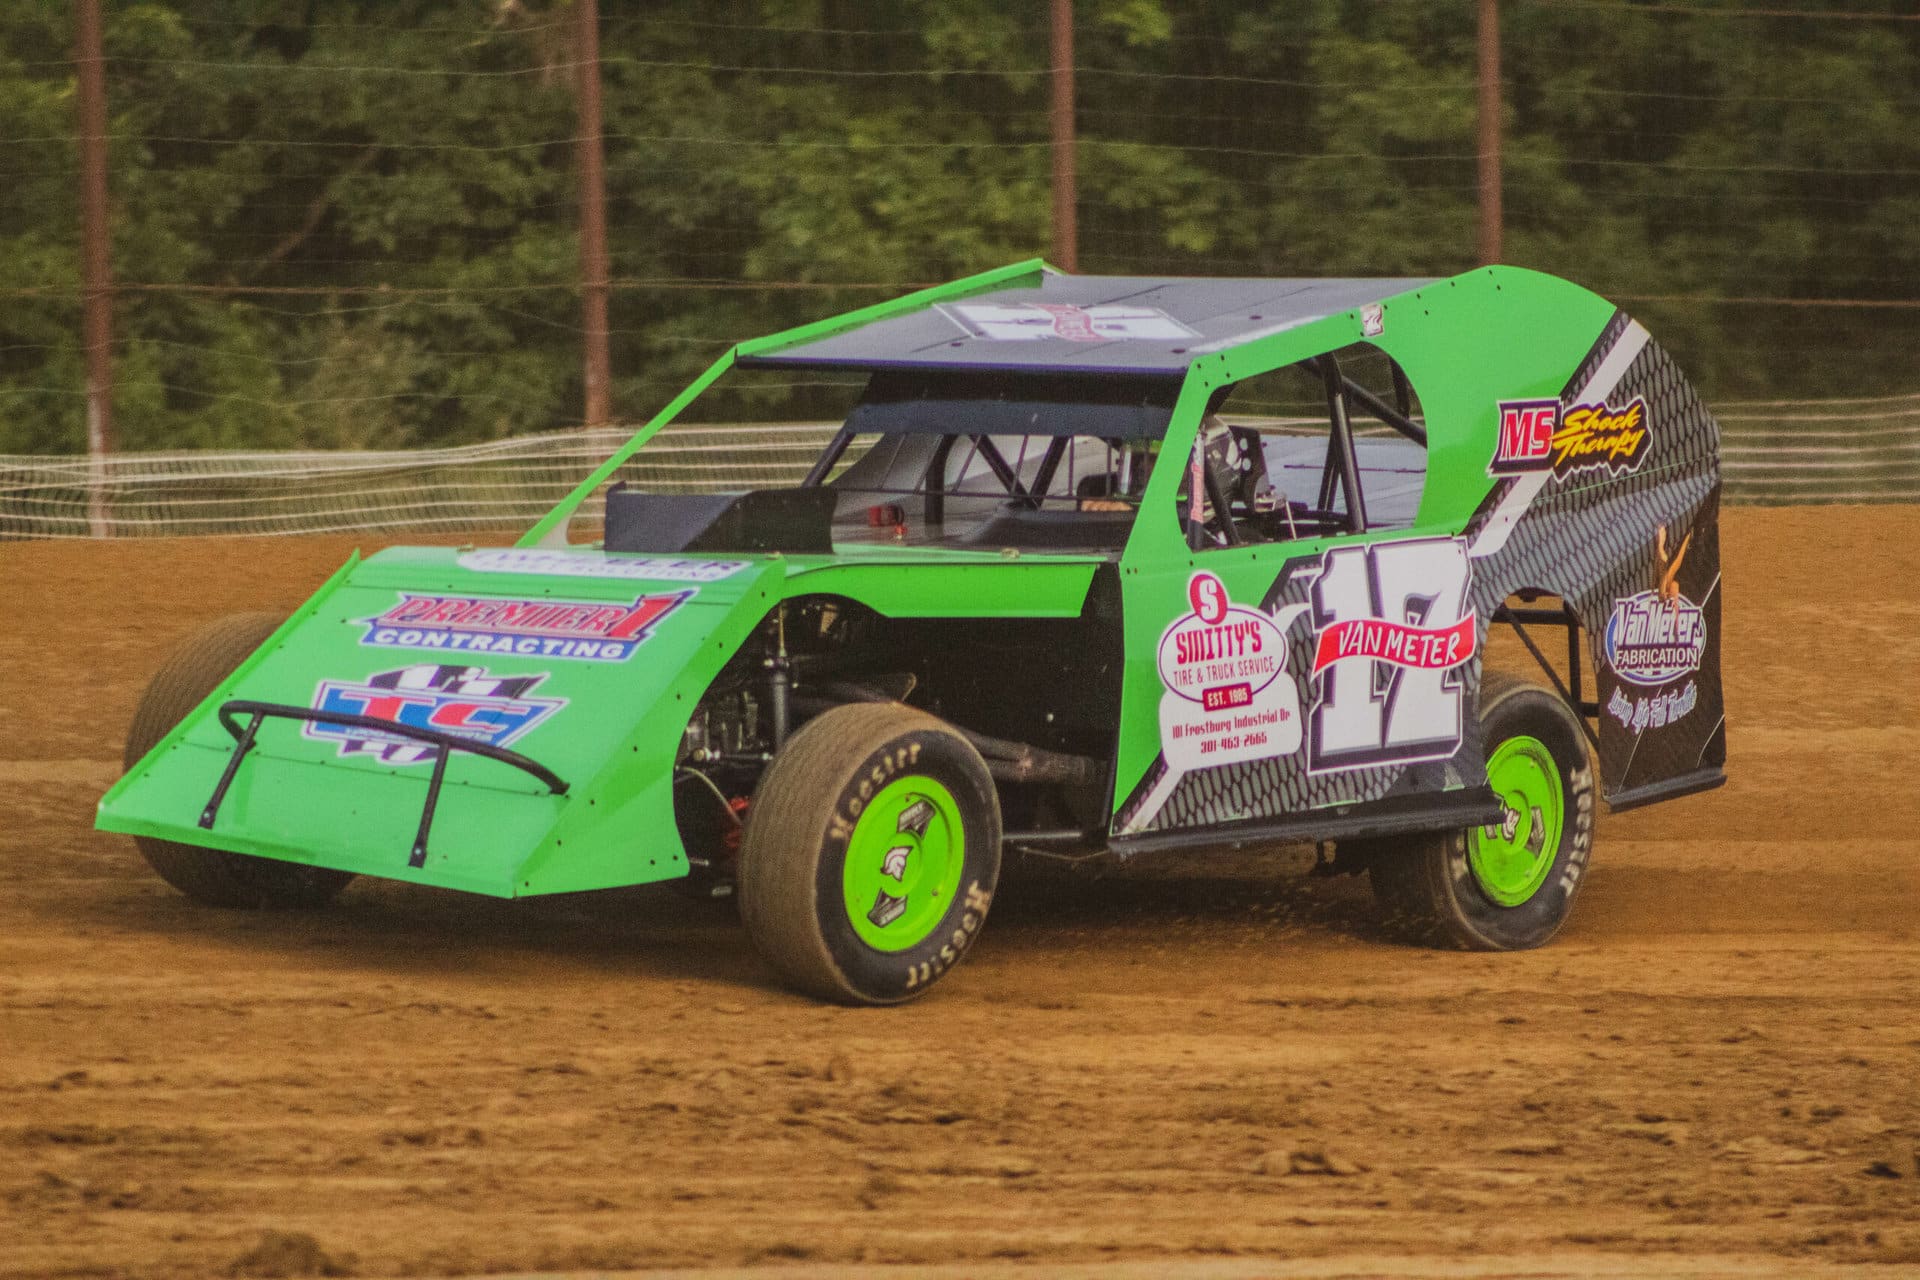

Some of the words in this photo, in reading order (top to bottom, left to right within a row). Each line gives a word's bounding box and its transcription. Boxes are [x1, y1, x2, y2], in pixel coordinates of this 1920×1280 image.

[1501, 408, 1556, 461] MS
[1550, 404, 1641, 440] Shock
[1551, 429, 1646, 467] Therapy
[382, 597, 630, 635] PREMIER
[373, 628, 625, 659] CONTRACTING
[1176, 619, 1263, 665] SMITTY'S
[1308, 538, 1471, 772] 17
[1615, 647, 1698, 667] FABRICATION
[1173, 668, 1193, 686] TIRE
[1206, 660, 1236, 682] TRUCK
[1238, 655, 1275, 677] SERVICE
[1207, 691, 1227, 707] EST.
[1185, 719, 1232, 737] Frostburg
[1234, 708, 1278, 729] Industrial
[1279, 708, 1291, 721] Dr
